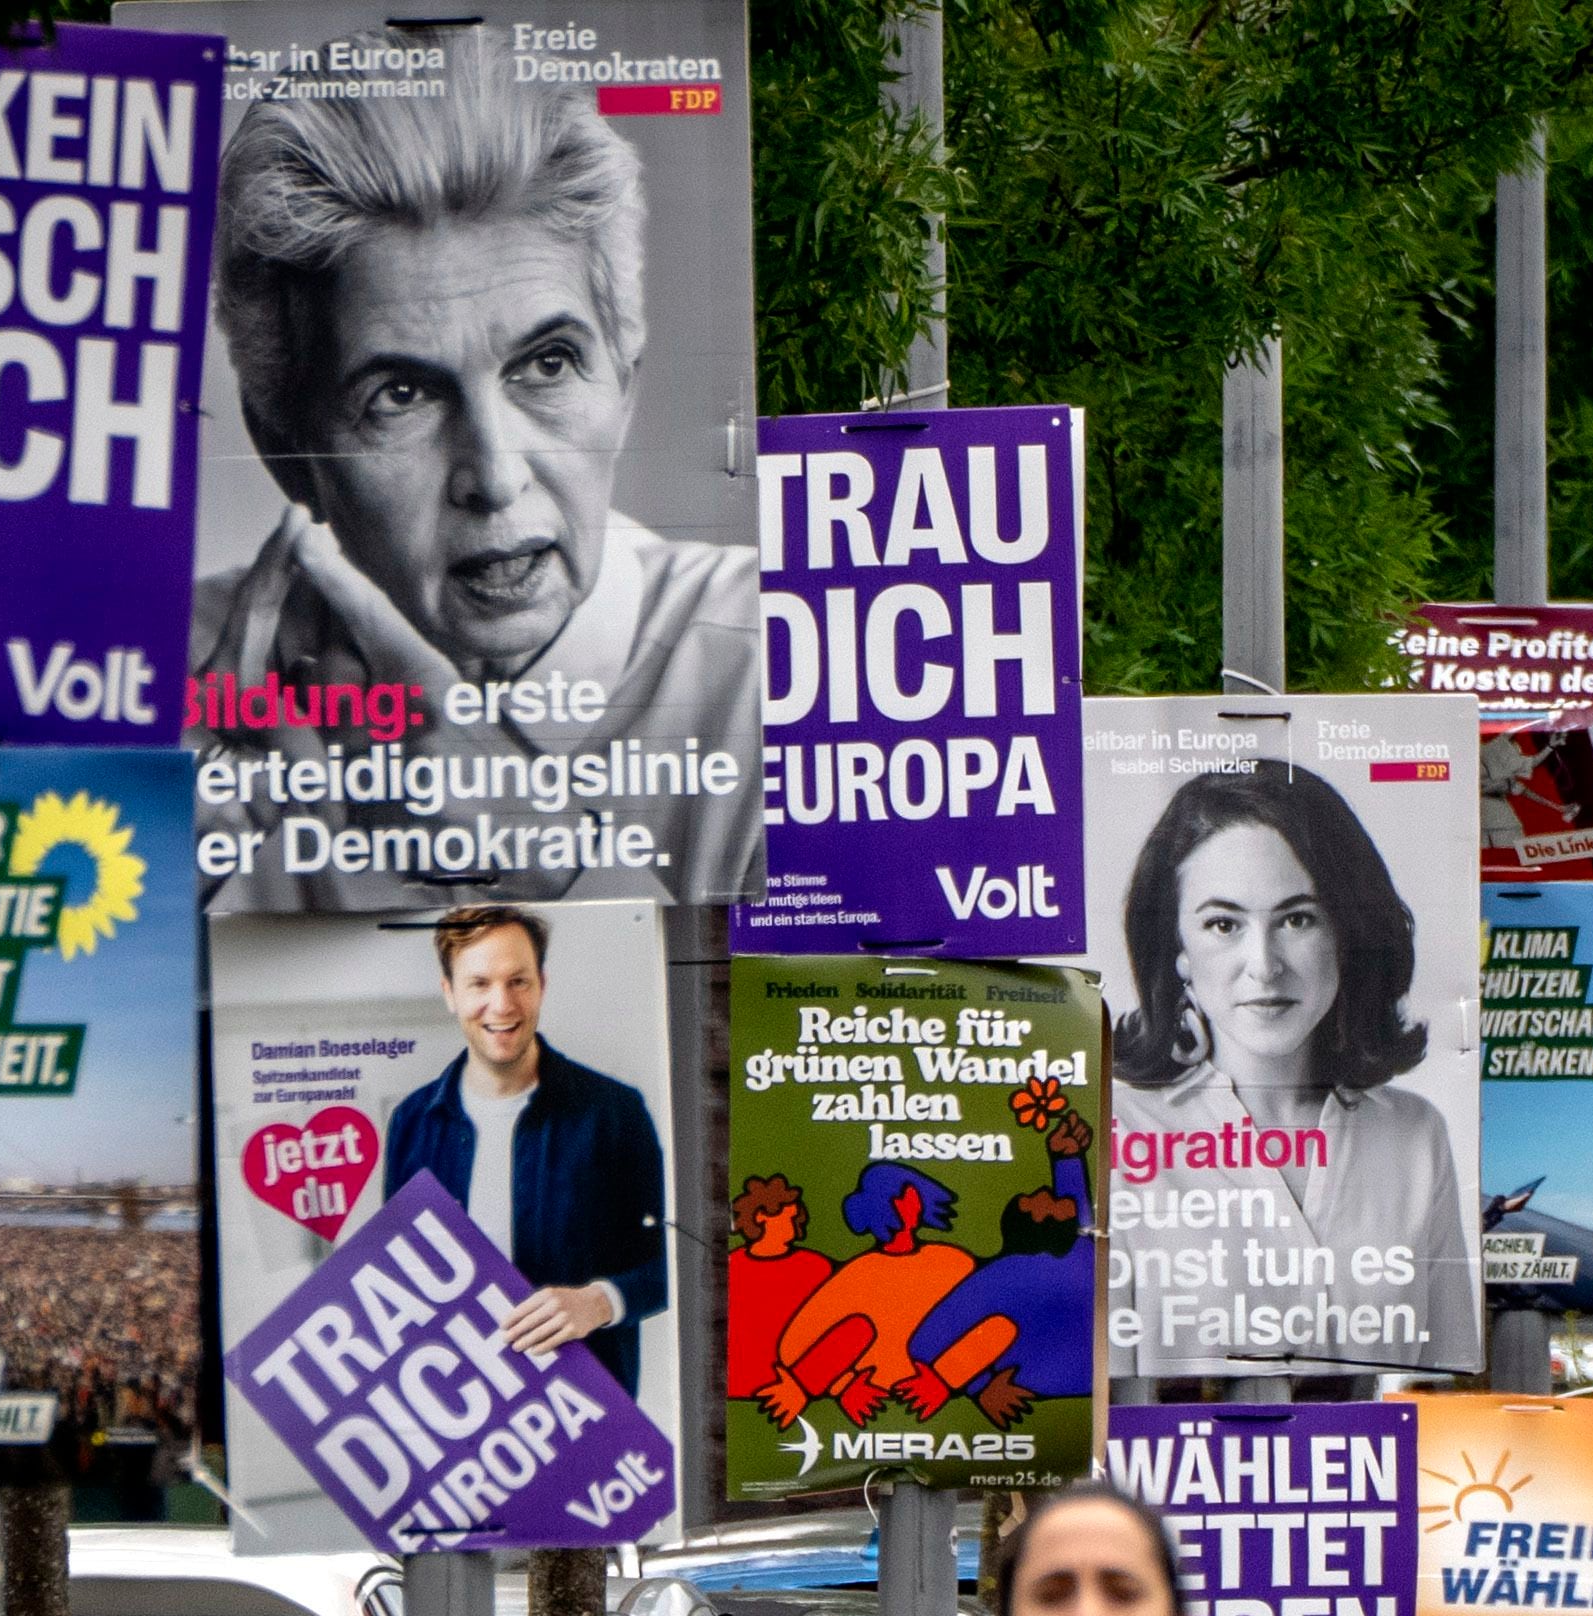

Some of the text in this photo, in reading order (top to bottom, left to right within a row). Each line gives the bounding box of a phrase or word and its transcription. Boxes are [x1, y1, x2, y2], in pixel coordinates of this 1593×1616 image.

[513, 22, 597, 51] Freie
[290, 44, 320, 72] in
[331, 42, 446, 76] Europa
[513, 54, 721, 83] Demokraten
[223, 75, 446, 101] ack-Zimmermann
[669, 90, 718, 111] FDP
[758, 444, 1049, 572] TRAU
[760, 581, 1057, 726] DICH
[6, 637, 157, 725] Volt
[1431, 662, 1553, 692] Kosten
[445, 670, 606, 726] erste
[1084, 729, 1259, 754] eitbar in Europa
[1317, 720, 1371, 740] Freie
[1111, 757, 1259, 775] Isabel Schnitzler
[1317, 740, 1450, 761] Demokraten
[195, 737, 740, 816] erteidigungslinie
[763, 736, 1057, 826] EUROPA
[1416, 764, 1448, 779] FDP
[196, 811, 671, 876] er Demokratie.
[1524, 842, 1555, 860] Die
[783, 874, 828, 888] Stimme
[934, 863, 1060, 921] Volt
[750, 911, 882, 928] und ein starkes Europa.
[1492, 931, 1569, 959] KLIMA
[765, 982, 1067, 1004] Frieden Solidarität Freiheit
[798, 1005, 1033, 1048] Reiche für
[251, 1039, 316, 1061] Damian
[745, 1045, 1089, 1091] grünen Wandel
[811, 1084, 963, 1122] zahlen
[262, 1122, 363, 1185] jetzt
[868, 1123, 1014, 1162] lassen
[1111, 1116, 1328, 1184] igration
[292, 1176, 347, 1222] du
[1110, 1186, 1292, 1231] euern.
[1108, 1238, 1415, 1289] onst tun es
[1482, 1239, 1537, 1256] ACHEN,
[1485, 1259, 1571, 1280] WAS ZÄHLT.
[252, 1209, 476, 1427] TRAU
[1109, 1293, 1430, 1348] e Falschen.
[315, 1284, 560, 1521] DICH
[389, 1376, 607, 1554] EUROPA
[833, 1432, 1036, 1461] MERA25
[1108, 1422, 1397, 1505] WÄHLEN
[566, 1450, 665, 1530] Volt
[970, 1471, 1062, 1487] mera25.de
[1163, 1511, 1397, 1590] ETTET
